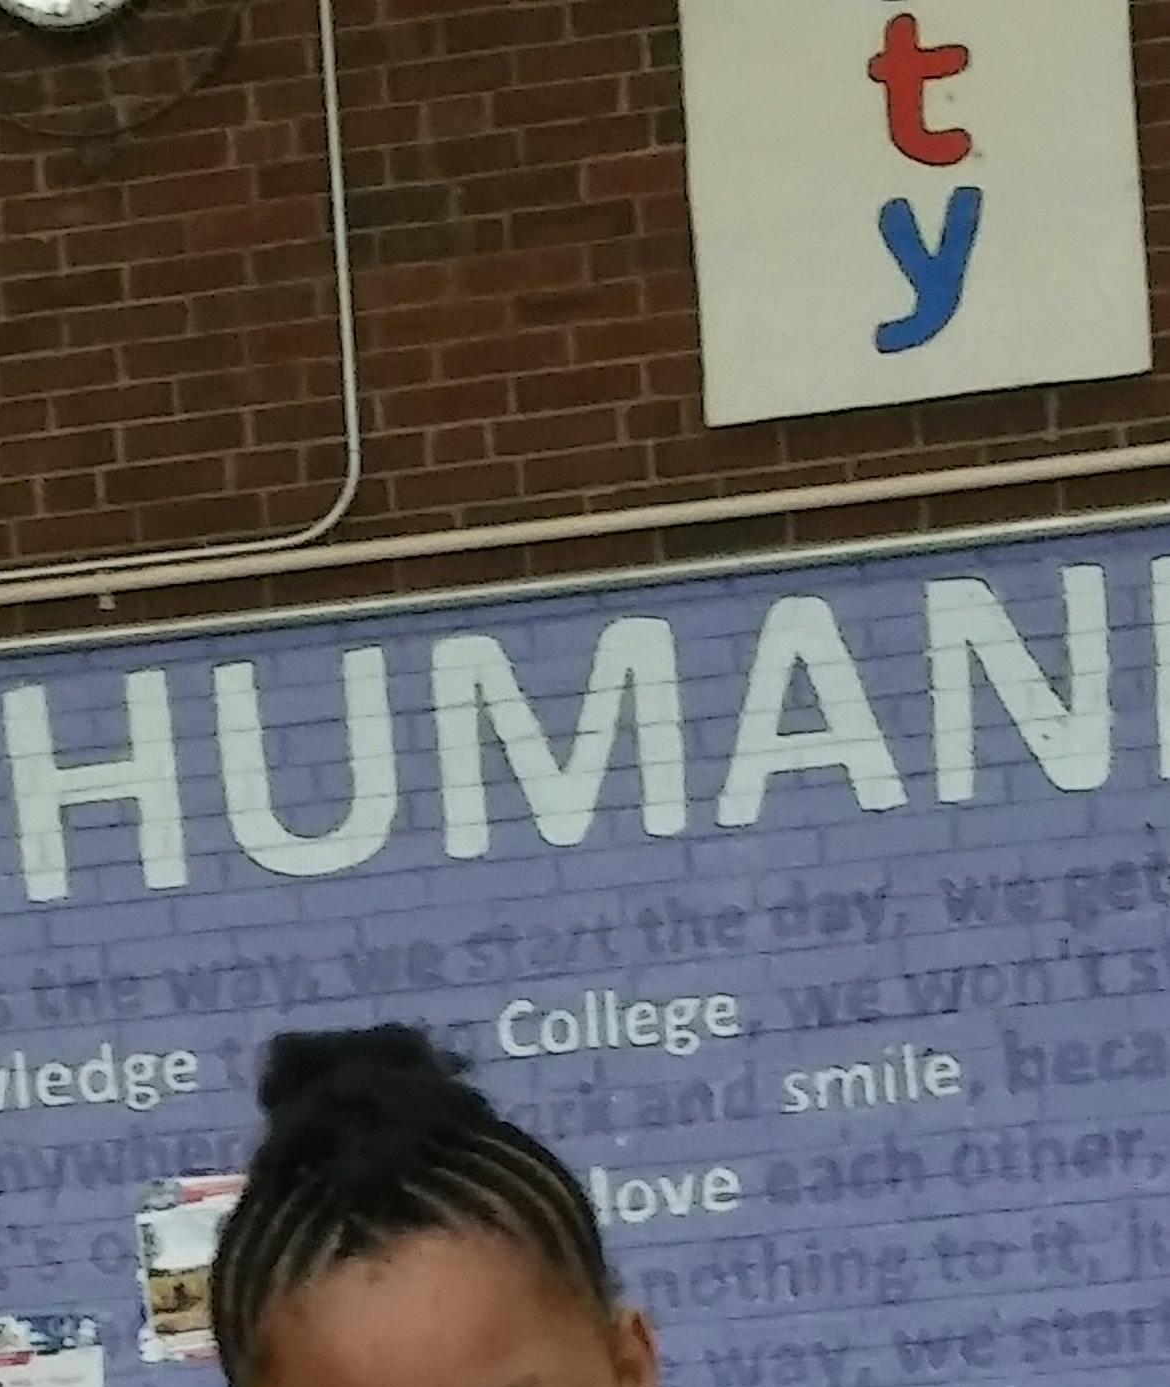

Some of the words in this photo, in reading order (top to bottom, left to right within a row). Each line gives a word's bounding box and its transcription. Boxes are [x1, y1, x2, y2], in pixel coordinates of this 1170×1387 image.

[30, 962, 146, 1021] the
[636, 897, 750, 957] the
[587, 1164, 742, 1226] love
